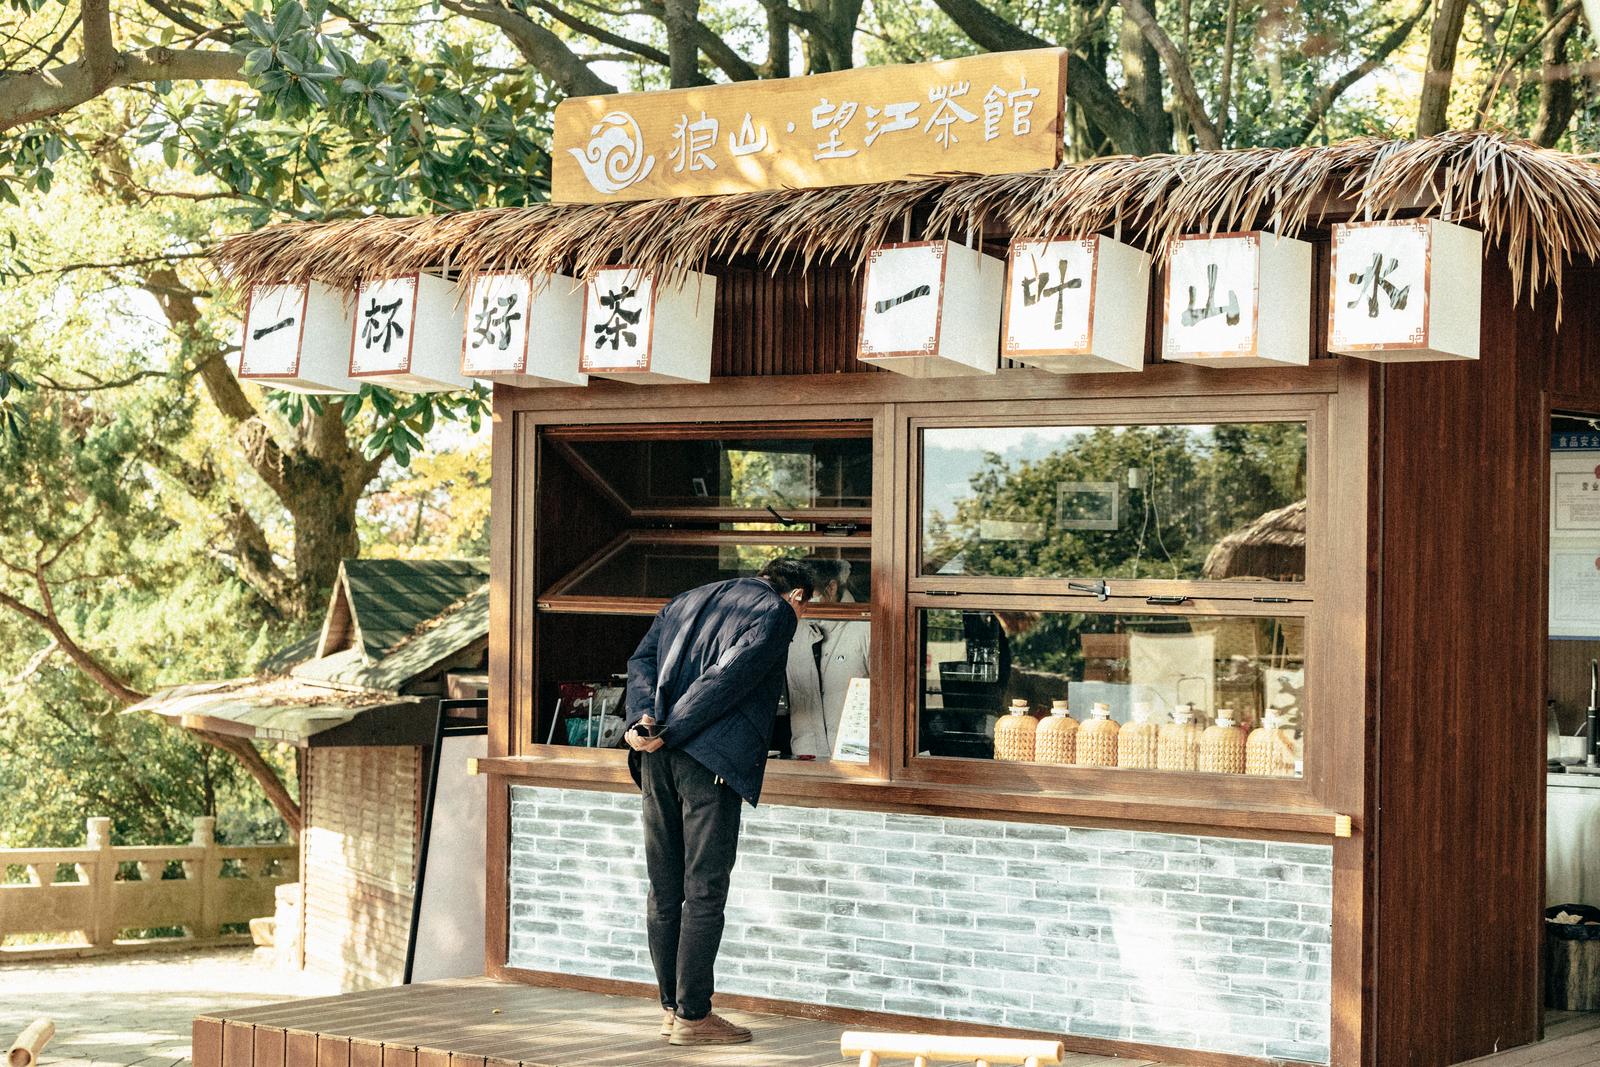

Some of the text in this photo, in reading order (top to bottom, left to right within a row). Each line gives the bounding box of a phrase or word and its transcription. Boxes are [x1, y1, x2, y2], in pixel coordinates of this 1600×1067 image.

[874, 284, 932, 315] 一
[1022, 258, 1082, 331] 叶
[1182, 263, 1241, 327] 山
[1346, 252, 1410, 319] 水
[252, 316, 296, 341] 一
[362, 297, 405, 353] 杯
[472, 293, 522, 351] 好
[593, 285, 642, 351] 茶
